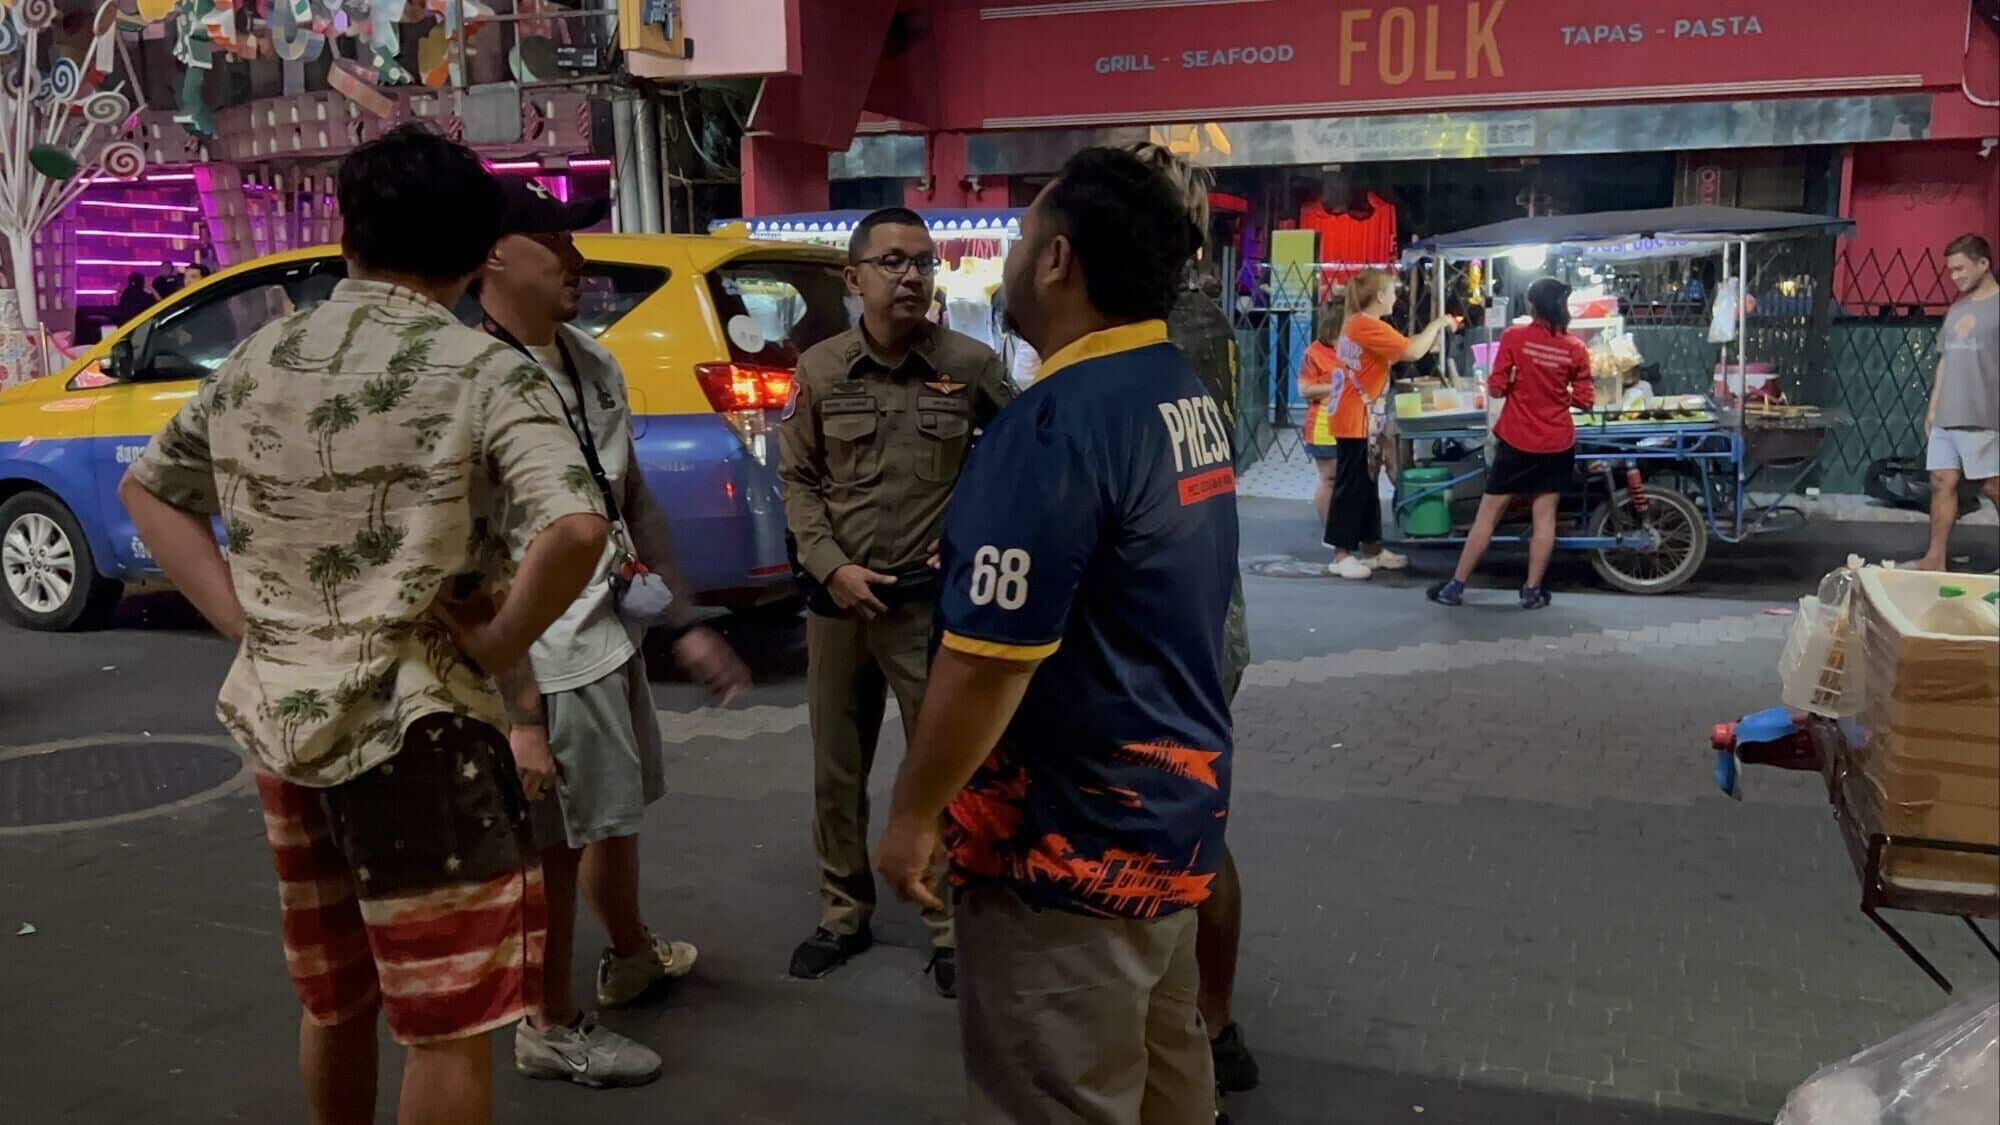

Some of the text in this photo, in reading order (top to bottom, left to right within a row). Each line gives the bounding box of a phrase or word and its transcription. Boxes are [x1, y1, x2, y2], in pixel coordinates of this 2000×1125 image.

[1338, 0, 1505, 86] FOLK
[1560, 24, 1644, 46] TAPAS
[1674, 15, 1763, 39] PASTA
[1094, 54, 1155, 74] GRILL
[1181, 44, 1294, 69] SEAFOOD
[969, 544, 1032, 611] 68
